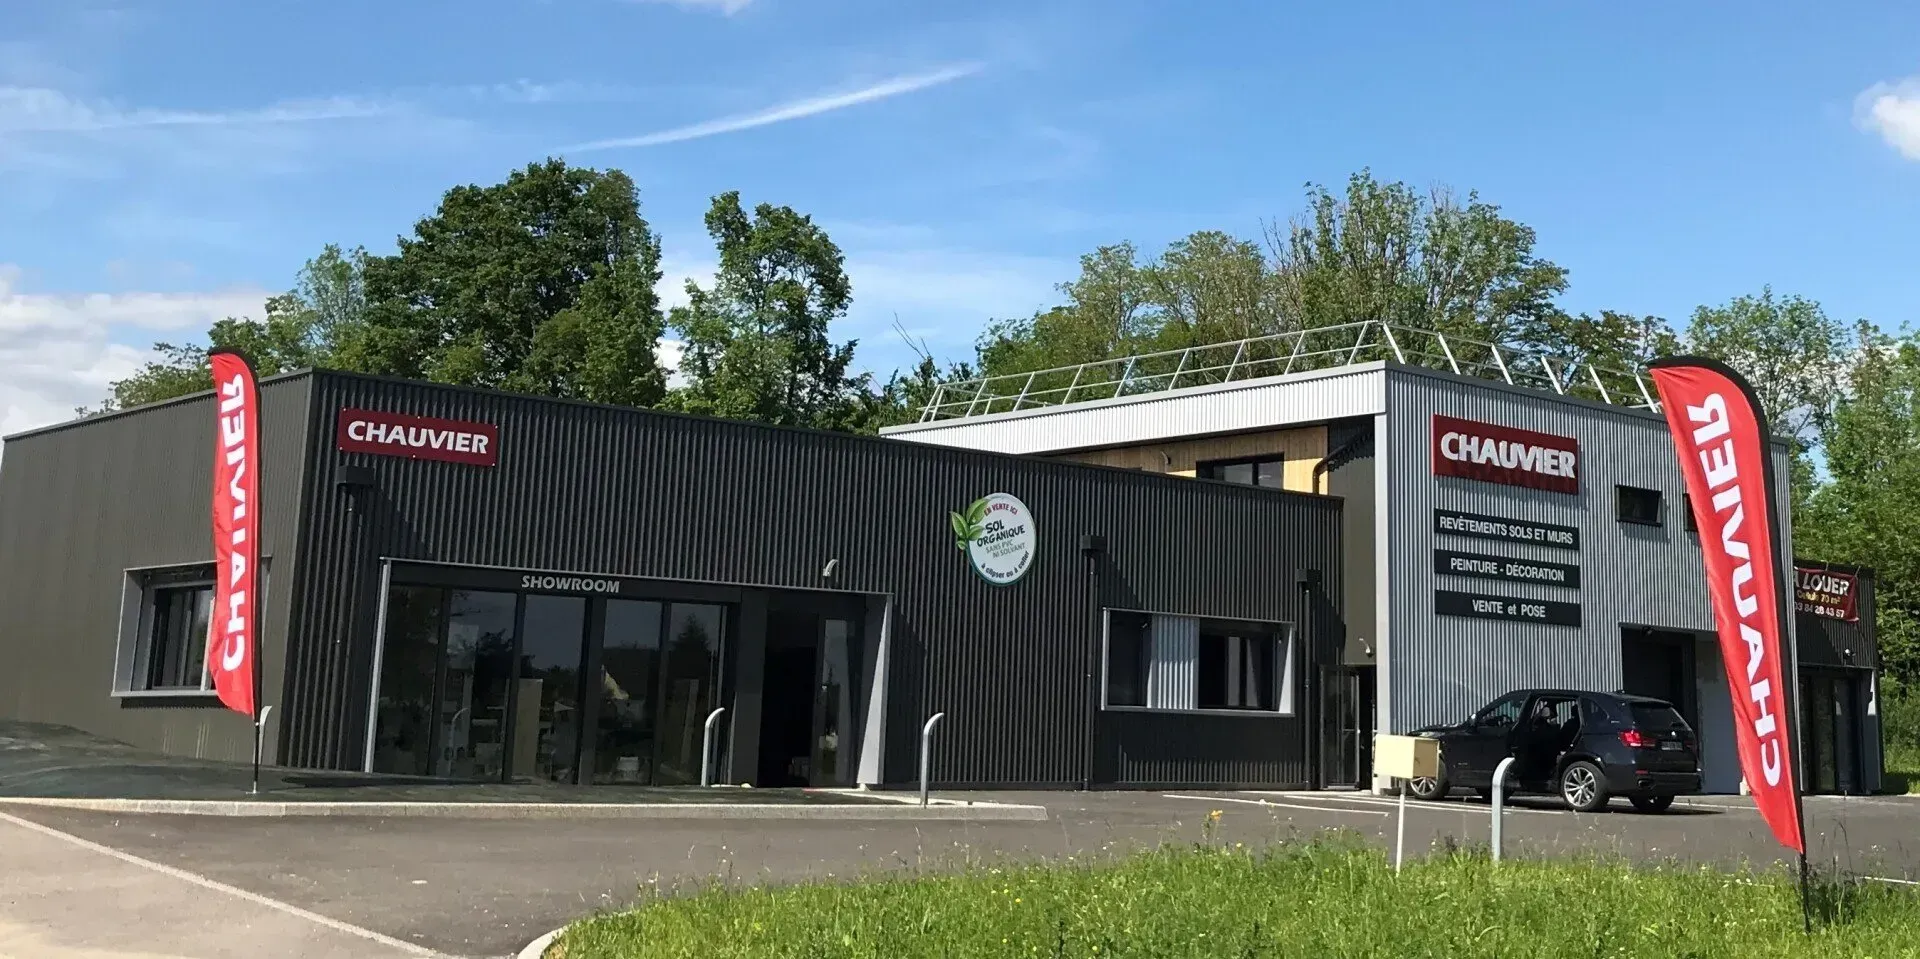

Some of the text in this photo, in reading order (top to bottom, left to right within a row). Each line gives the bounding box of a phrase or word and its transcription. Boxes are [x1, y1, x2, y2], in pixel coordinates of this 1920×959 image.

[347, 420, 489, 454] CHAUVIER
[1440, 431, 1576, 478] CHAUVIER
[984, 503, 1018, 516] EN VENTE ICI
[977, 525, 1026, 547] ORGANIQUE
[985, 519, 1005, 534] SOL
[1439, 515, 1573, 545] REVÊTEMENTS SOLS ET MURS
[986, 539, 1013, 554] SANS PVC
[1000, 542, 1026, 557] SOLVANT
[985, 567, 1005, 578] clipser
[1018, 551, 1030, 569] coller
[1450, 557, 1498, 574] PEINTURE
[1505, 562, 1565, 581] DÉCORATION
[521, 575, 620, 593] SHOWROOM
[1802, 572, 1849, 596] LOUER
[1821, 593, 1830, 603] 70
[1472, 599, 1546, 618] VENTE et POSE
[1825, 607, 1835, 617] 43
[1835, 609, 1845, 618] 57
